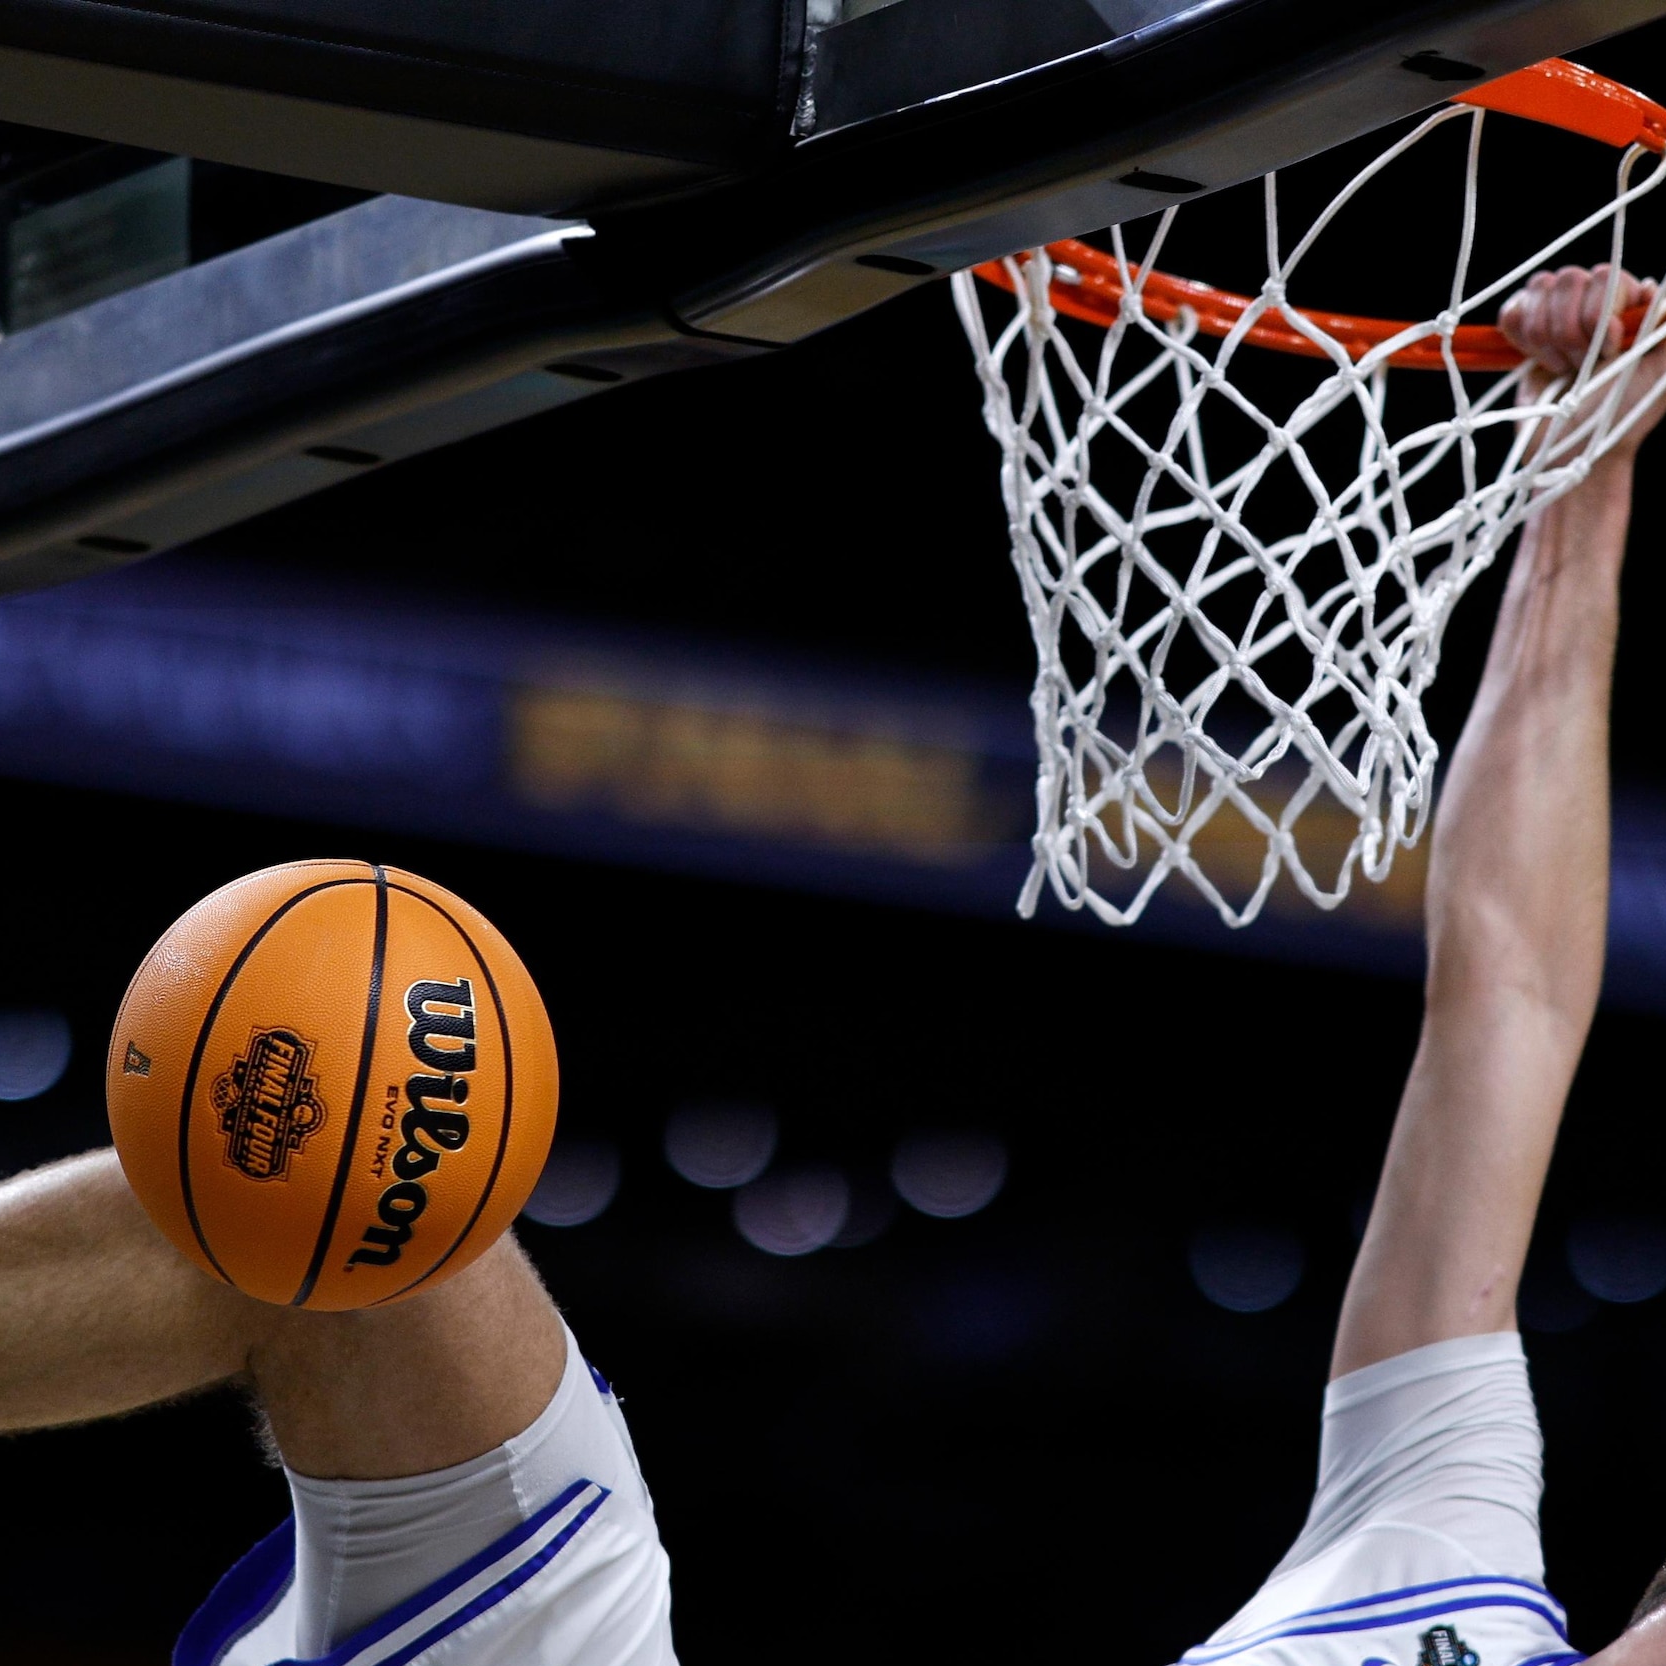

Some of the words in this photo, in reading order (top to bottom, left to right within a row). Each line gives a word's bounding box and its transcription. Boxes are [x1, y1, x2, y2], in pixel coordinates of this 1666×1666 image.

[257, 1038, 296, 1107] FINAL
[350, 976, 477, 1268] Wilson
[382, 1086, 399, 1129] EVO
[246, 1108, 280, 1175] FOUR
[370, 1136, 391, 1179] NXT
[1432, 1630, 1456, 1666] FINAL
